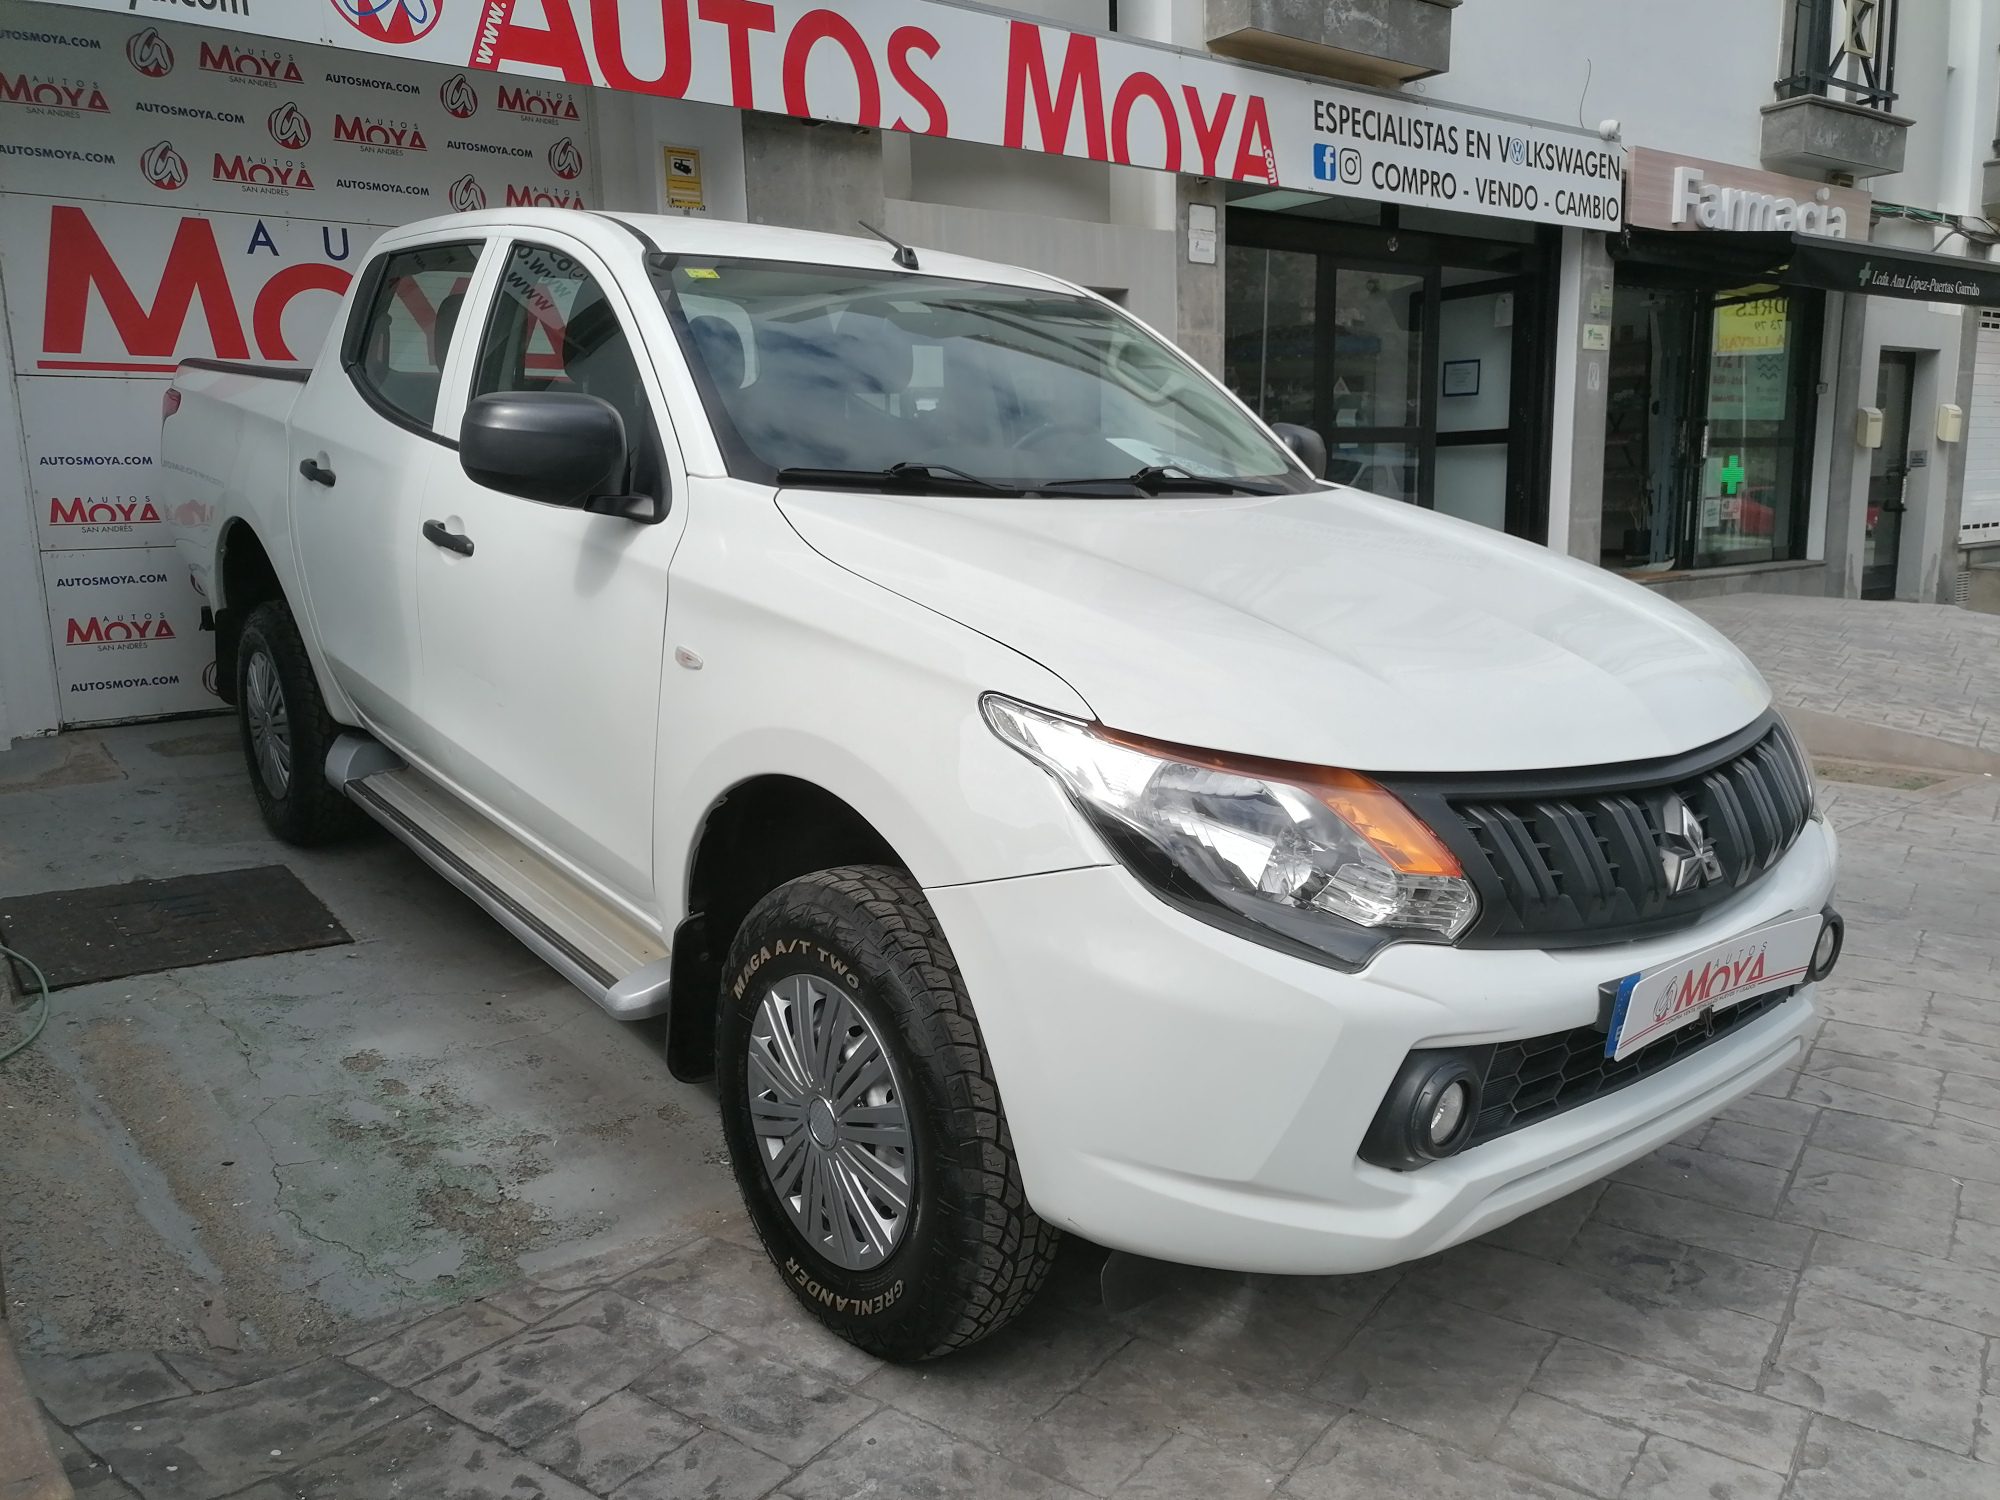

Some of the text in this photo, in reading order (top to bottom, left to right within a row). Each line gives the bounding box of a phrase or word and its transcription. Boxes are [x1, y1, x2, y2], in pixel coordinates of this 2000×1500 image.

[200, 41, 303, 82] MOYA
[234, 46, 293, 61] AUTOS
[32, 75, 99, 89] AUTOS
[228, 75, 246, 84] SAN
[325, 73, 420, 95] AUTOSMOYA.COM
[0, 72, 109, 111] MOYA
[468, 0, 1279, 187] AUTOS MOYA
[526, 89, 573, 101] AUTOS
[25, 106, 45, 115] SAN
[498, 85, 580, 119] MOYA
[136, 101, 245, 124] AUTOSMOYA.COM
[521, 115, 535, 123] SAN
[334, 114, 427, 148] MOYA
[365, 117, 418, 130] AUTOS
[1314, 100, 1458, 155] ESPECIALISTAS
[1466, 129, 1490, 160] EN
[360, 145, 375, 153] SAN
[447, 140, 533, 158] AUTOSMOYA.COM
[213, 153, 315, 188] MOYA
[247, 156, 306, 169] AUTOS
[242, 185, 258, 194] SAN
[336, 178, 429, 196] AUTOSMOYA.COM
[533, 186, 580, 197] AUTOS
[1372, 162, 1456, 200] COMPRO
[1475, 177, 1538, 211] VENDO
[1555, 189, 1619, 222] CAMBIO
[506, 184, 584, 210] MOYA
[1672, 166, 1848, 238] Farmacia
[1890, 274, 1905, 288] Ana
[1955, 281, 1980, 296] Garrido
[39, 456, 153, 466] AUTOSMOYA.COM
[88, 495, 151, 504] AUTOS
[50, 497, 161, 523] MOYA
[82, 525, 100, 534] SAN
[57, 573, 167, 587] AUTOSMOYA.COM
[103, 611, 165, 623] AUTOS
[67, 617, 176, 643] MOYA
[97, 643, 115, 652] SAN
[71, 675, 179, 693] AUTOSMOYA.COM
[1714, 941, 1767, 969] AUTOS
[733, 939, 860, 1000] MAGA A/T TWO
[1674, 952, 1765, 1013] MOYA
[785, 1257, 904, 1316] GRENLANDER
